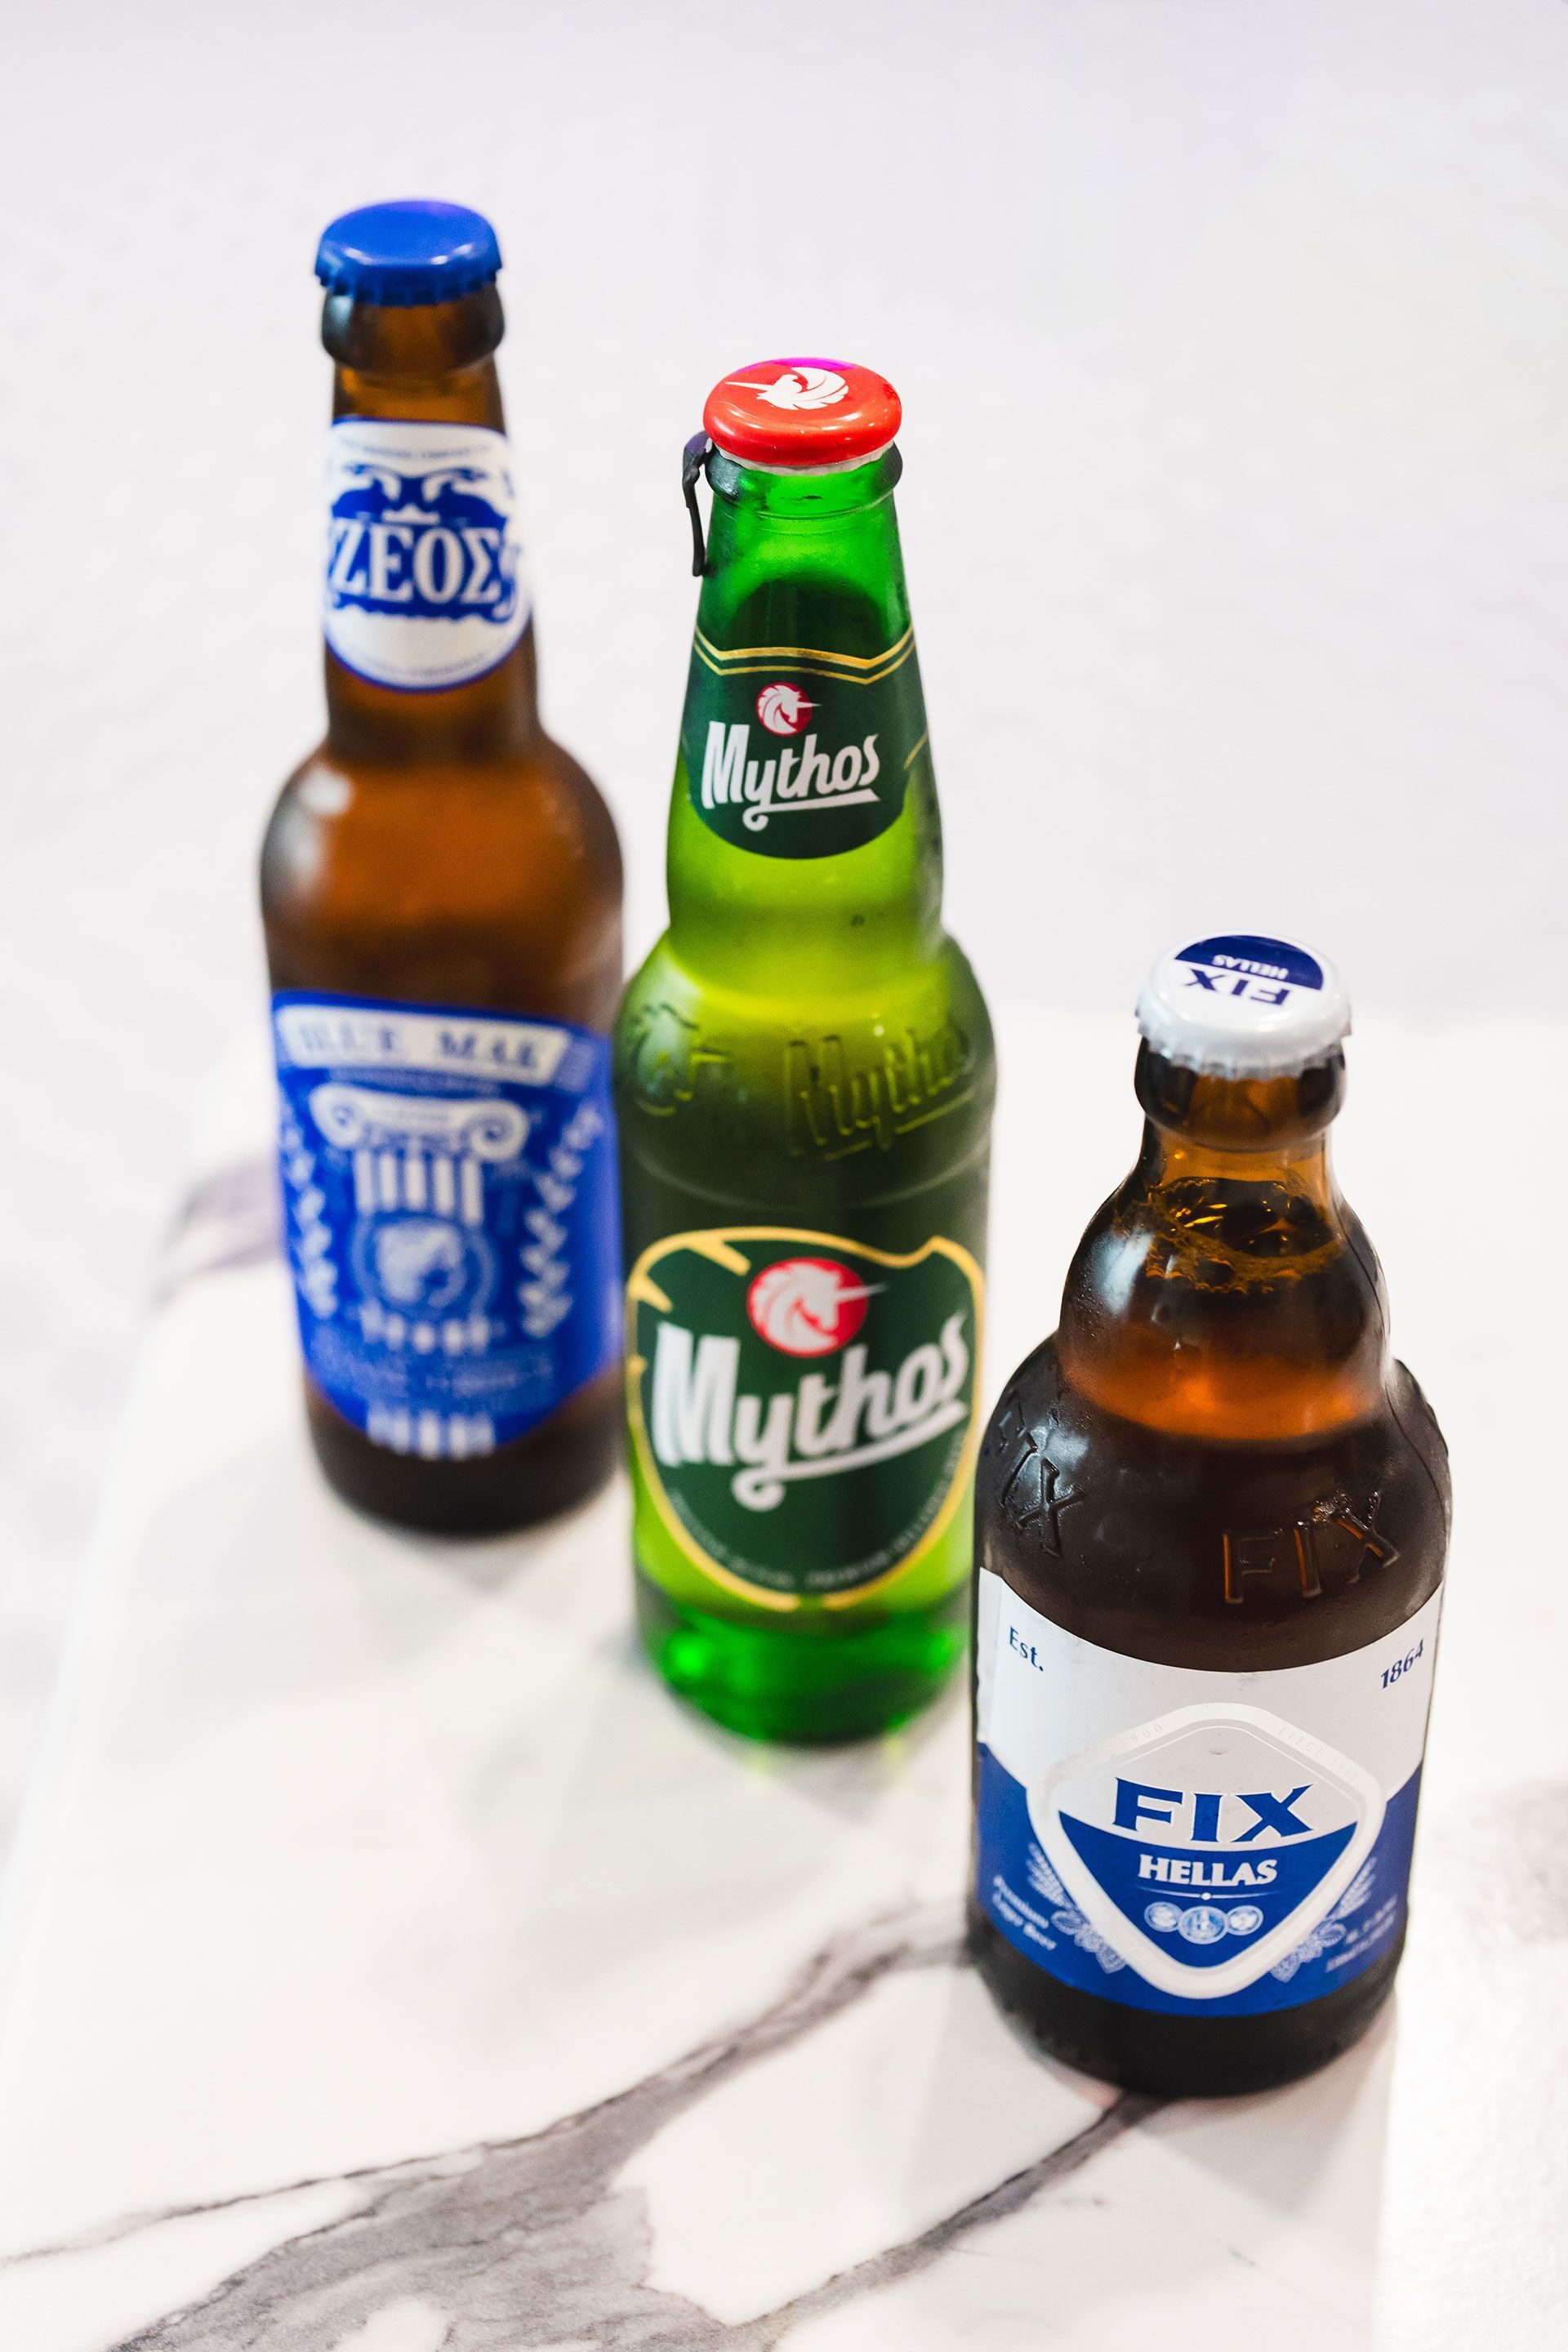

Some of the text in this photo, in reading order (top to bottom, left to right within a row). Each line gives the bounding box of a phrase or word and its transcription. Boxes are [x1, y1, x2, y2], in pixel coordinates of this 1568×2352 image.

[702, 720, 880, 831] Mythos
[1184, 968, 1291, 1005] FIX
[653, 1312, 970, 1512] Mythos
[1222, 1488, 1401, 1603] FIX
[1009, 1625, 1044, 1672] Est.
[1381, 1638, 1423, 1689] 1864
[1113, 1778, 1314, 1842] FIX
[1138, 1854, 1278, 1886] HELLAS
